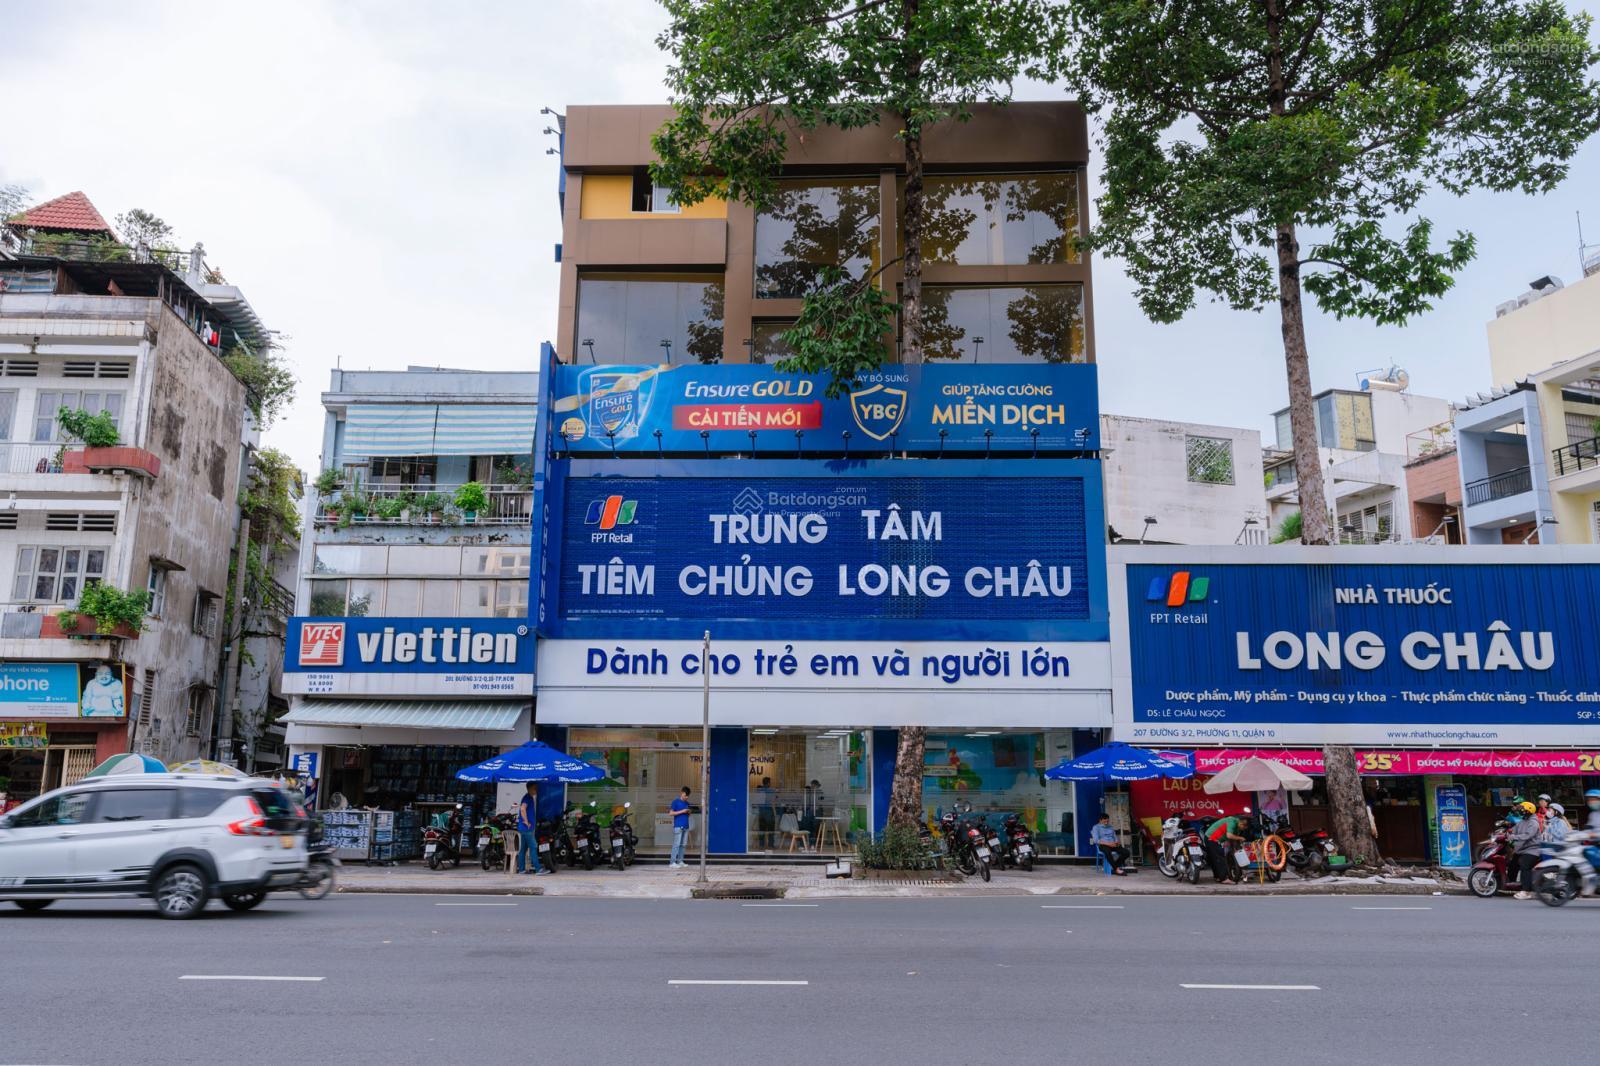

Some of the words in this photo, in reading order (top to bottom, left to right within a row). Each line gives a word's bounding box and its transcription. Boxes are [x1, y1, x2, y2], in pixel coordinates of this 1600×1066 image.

[885, 374, 909, 383] SUNG
[684, 381, 750, 398] Ensure
[752, 380, 813, 397] GOLD
[942, 384, 971, 396] GIÚP
[973, 383, 1005, 396] TĂNG
[1007, 384, 1053, 396] CƯỜNG
[595, 393, 633, 410] Ensure
[611, 404, 633, 414] GOLD
[688, 408, 718, 426] CẢI
[721, 405, 761, 426] TIẾN
[765, 407, 801, 426] MỚI
[860, 404, 898, 420] YBG
[932, 395, 996, 425] MIỄN
[1002, 404, 1065, 431] DỊCH
[709, 514, 828, 544] TRUNG
[861, 503, 942, 541] TÂM
[592, 533, 607, 543] FPT
[609, 533, 633, 543] Retail
[578, 556, 655, 595] TIÊM
[678, 553, 814, 596] CHỦNG
[838, 564, 951, 598] LONG
[964, 559, 1072, 598] CHÂU
[1335, 584, 1379, 604] NHÀ
[1384, 582, 1452, 605] THUỐC
[1150, 613, 1170, 624] FPT
[1174, 613, 1208, 624] Retail
[303, 625, 341, 643] VTEC
[357, 626, 518, 664] viettien
[1236, 630, 1386, 671] LONG
[1400, 620, 1555, 671] CHÂU
[586, 647, 668, 675] Dành
[681, 648, 741, 675] cho
[754, 644, 798, 675] trẻ
[810, 654, 859, 676] em
[871, 649, 910, 676] và
[922, 648, 1011, 684] người
[1022, 647, 1070, 677] lớn
[1165, 690, 1195, 701] Dược
[1197, 688, 1232, 702] phẩm,
[1234, 690, 1251, 702] Mỹ
[1255, 688, 1287, 702] phẩm
[1297, 691, 1330, 704] Dụng
[1332, 694, 1346, 704] cụ
[1357, 691, 1387, 702] khoa
[1401, 691, 1430, 703] Thực
[1432, 689, 1465, 703] phẩm
[1467, 690, 1495, 701] chức
[1497, 692, 1527, 704] năng
[1536, 690, 1573, 702] Thuốc
[1576, 692, 1600, 702] dinh
[1174, 708, 1197, 717] CHÂU
[1200, 709, 1226, 718] NGỌC
[1150, 728, 1179, 737] ĐƯỜNG
[1197, 728, 1230, 737] PHƯỜNG
[1242, 729, 1265, 738] QUẬN
[1268, 729, 1275, 737] 10
[1387, 729, 1498, 739] www.nhathuoclongchau.com
[1285, 757, 1313, 766] NĂNG
[1363, 754, 1402, 770] 35%
[1464, 758, 1492, 768] PHẨM
[1524, 759, 1548, 769] LOẠT
[1164, 800, 1179, 812] TẠI
[1180, 799, 1195, 809] SÀI
[1197, 799, 1219, 809] GÒN
